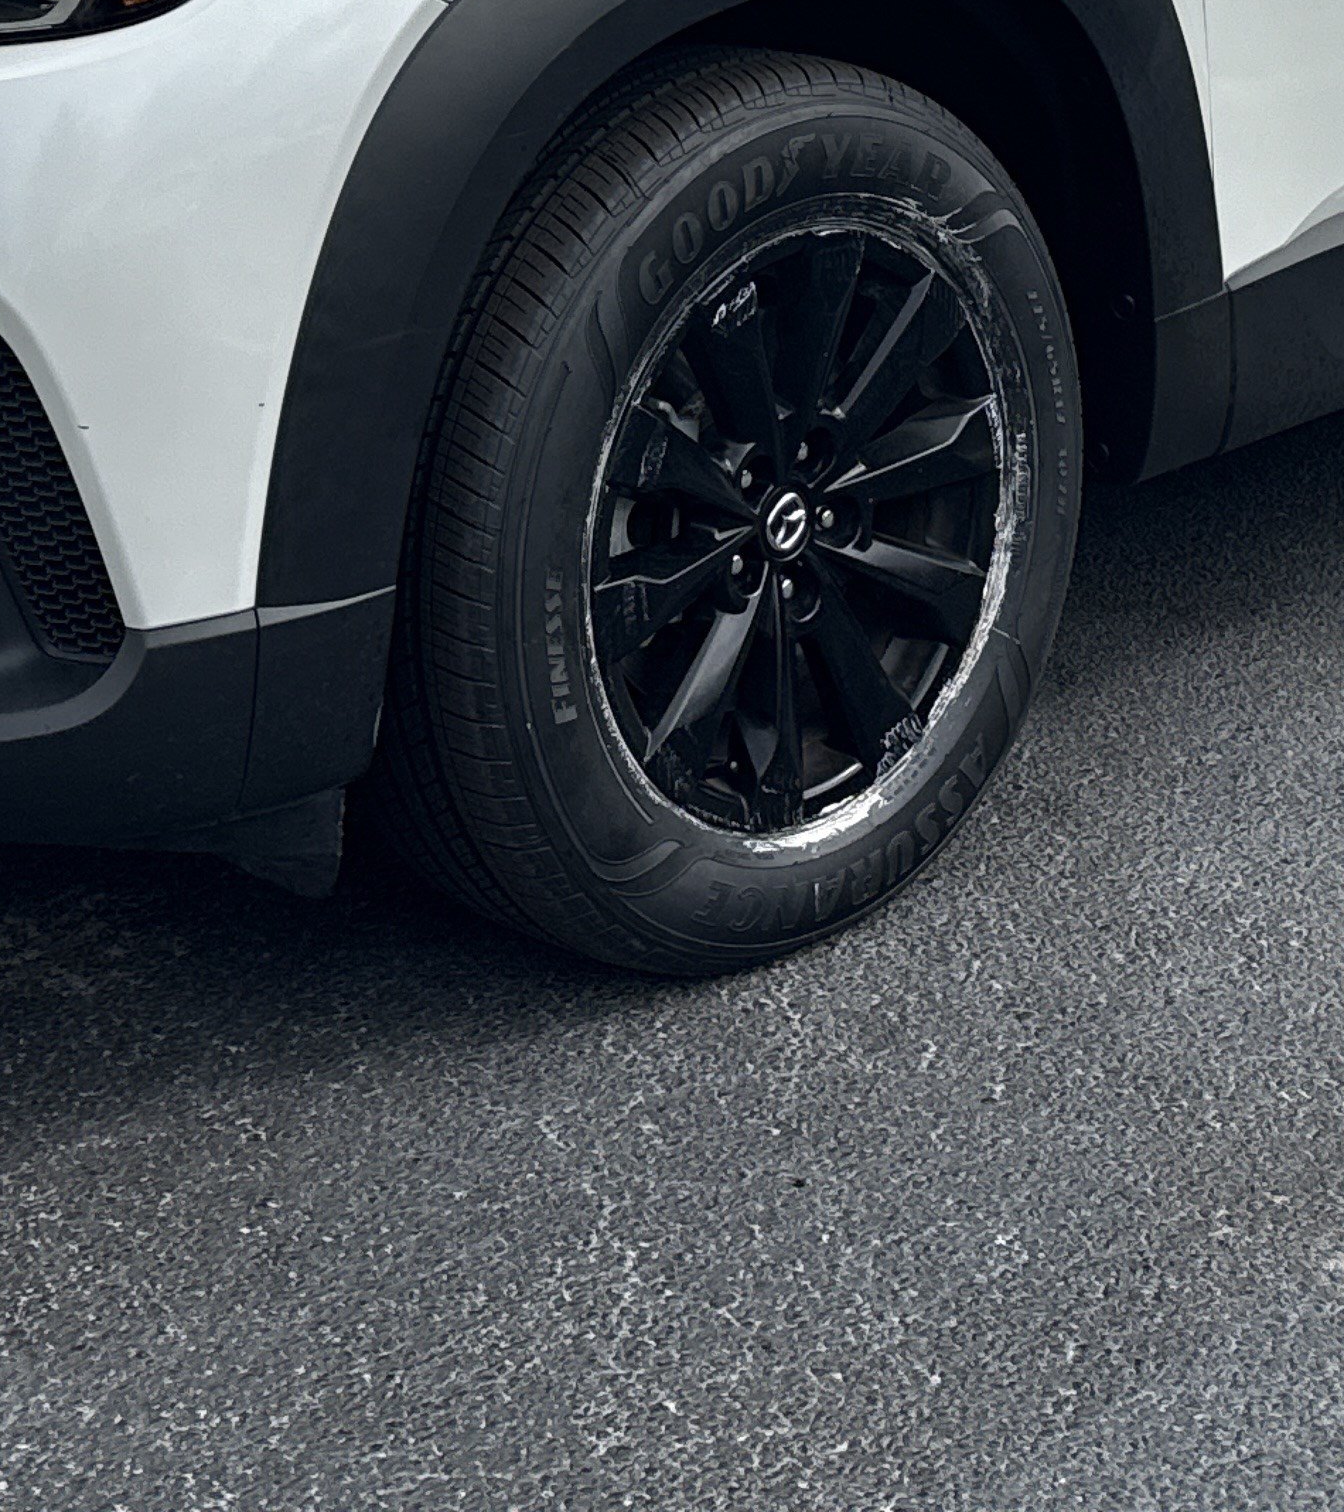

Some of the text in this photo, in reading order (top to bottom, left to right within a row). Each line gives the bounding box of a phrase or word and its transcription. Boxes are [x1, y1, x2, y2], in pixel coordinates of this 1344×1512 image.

[638, 133, 953, 306] GOODYEAR
[544, 566, 578, 724] FINESSE
[691, 731, 987, 932] ASSURANCE
